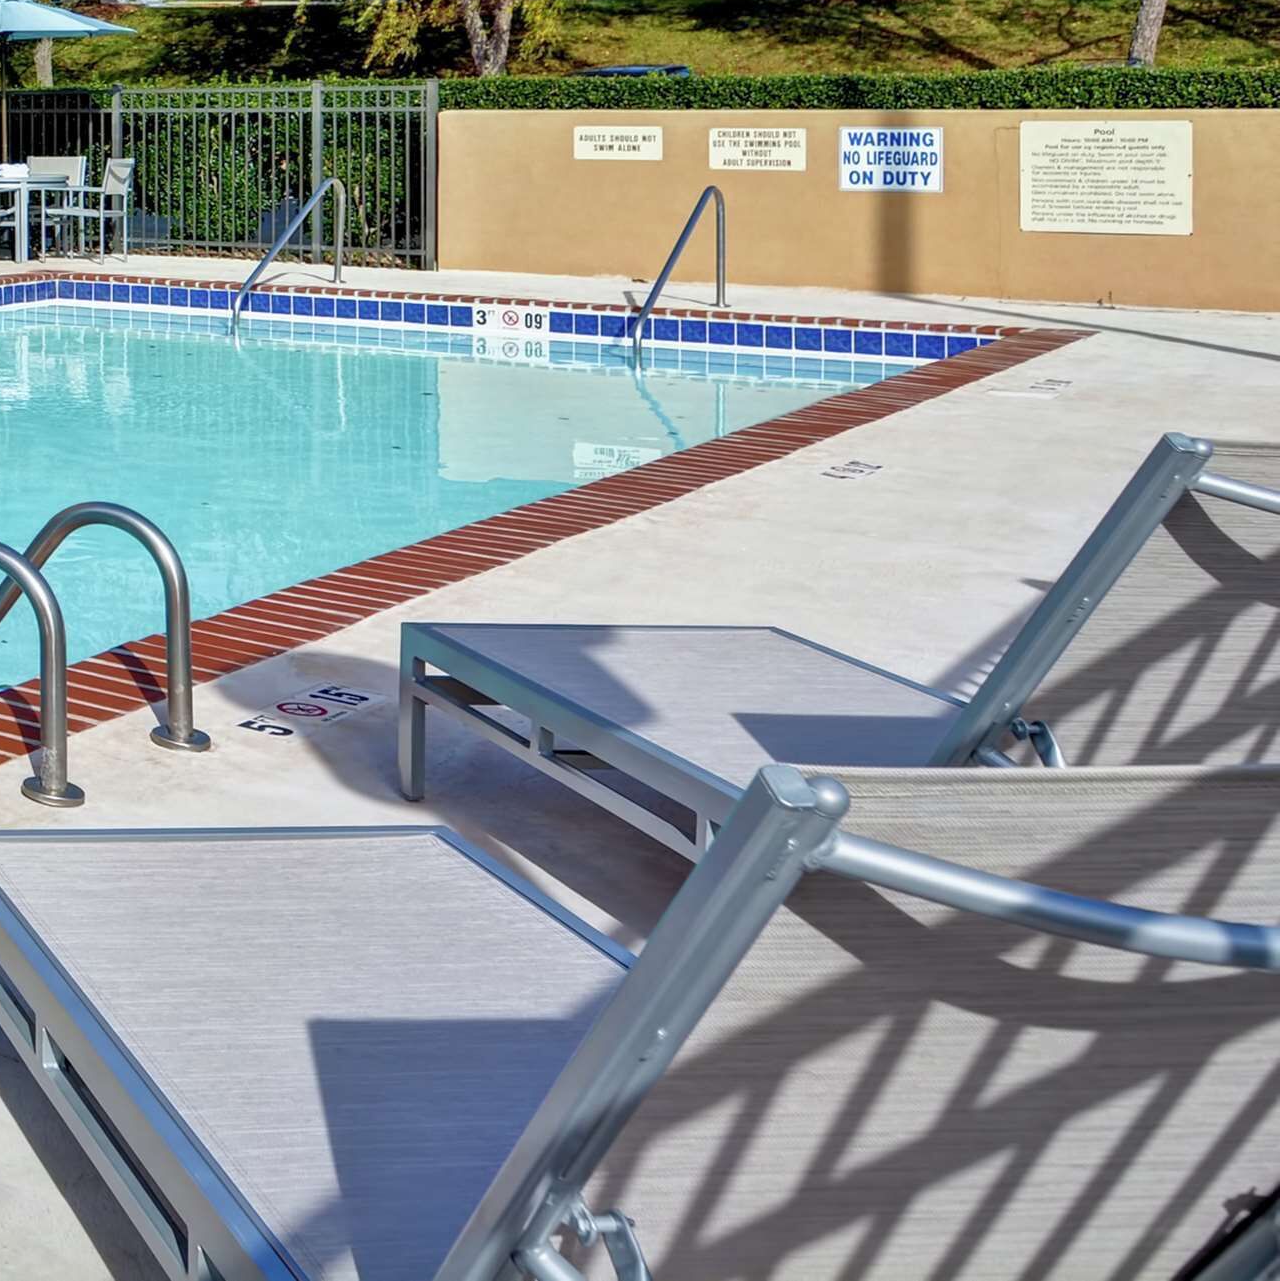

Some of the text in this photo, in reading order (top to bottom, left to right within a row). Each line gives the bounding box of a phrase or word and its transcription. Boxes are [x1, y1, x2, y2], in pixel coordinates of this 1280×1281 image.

[783, 131, 796, 139] NOT
[848, 132, 934, 147] WARNING
[594, 144, 640, 152] SWIM ALONE
[744, 140, 781, 148] SWIMMING
[843, 151, 938, 166] NO LIFEGUARD
[849, 170, 931, 186] ON DUTY
[476, 310, 487, 325] 3
[238, 720, 294, 736] 5
